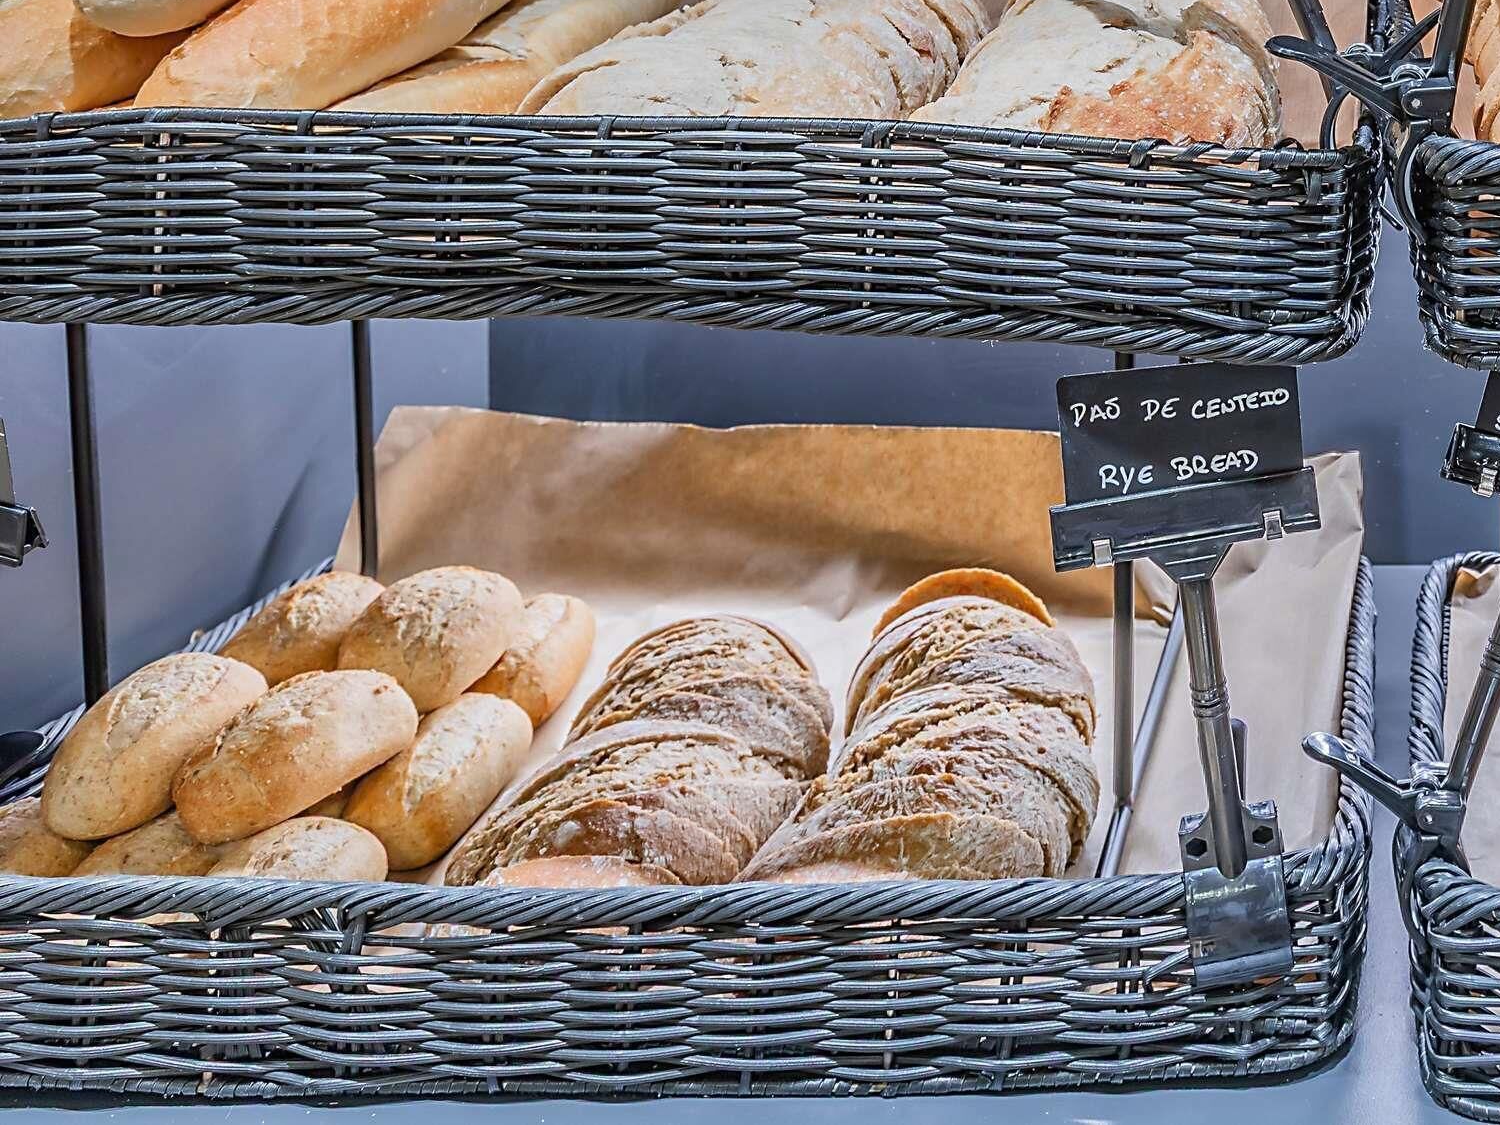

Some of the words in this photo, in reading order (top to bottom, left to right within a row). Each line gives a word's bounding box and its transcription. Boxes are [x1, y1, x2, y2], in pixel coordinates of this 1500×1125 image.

[1140, 397, 1180, 422] DE
[1099, 464, 1154, 495] RYE
[1170, 449, 1259, 482] BREAD
